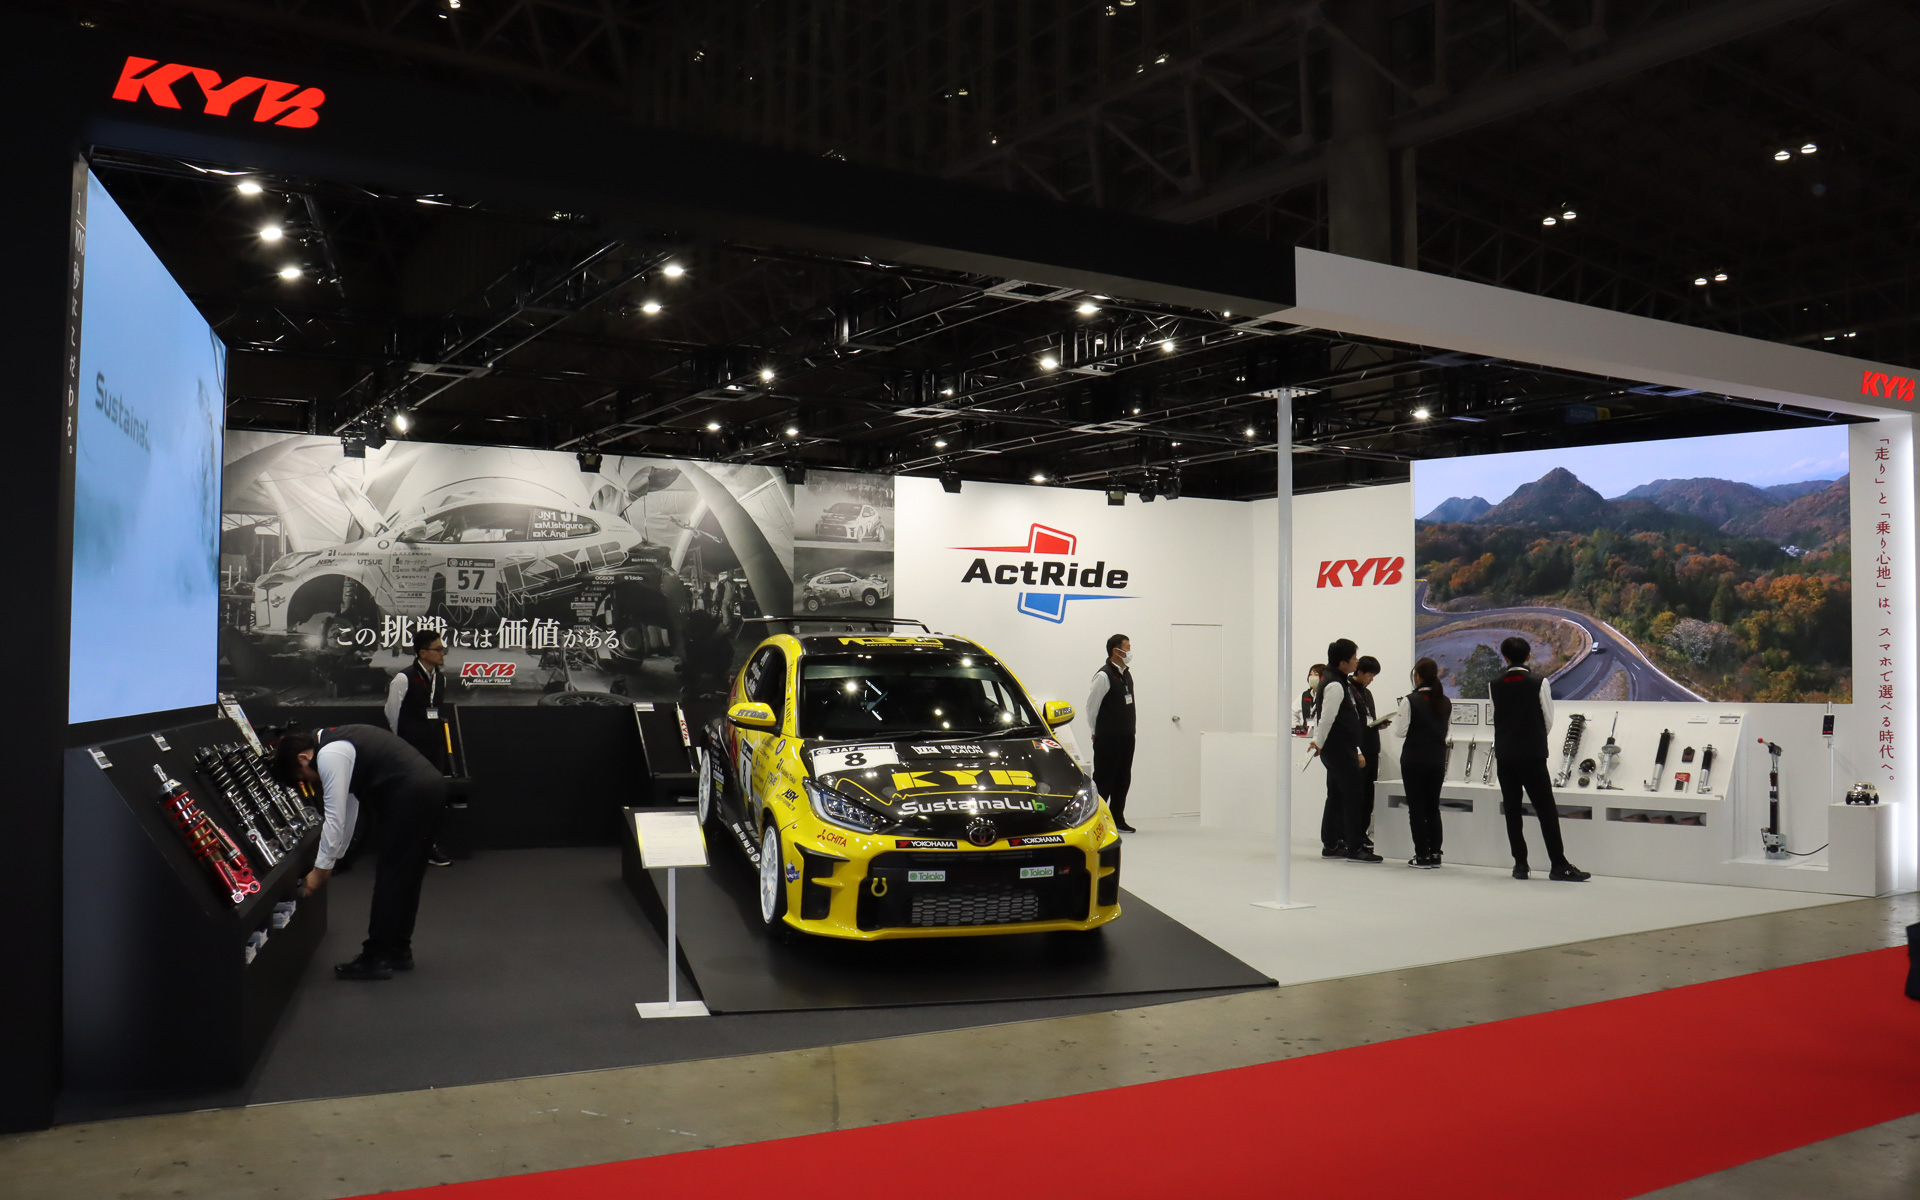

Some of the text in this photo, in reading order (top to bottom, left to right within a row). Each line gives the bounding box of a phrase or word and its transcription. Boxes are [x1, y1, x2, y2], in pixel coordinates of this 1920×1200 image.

[112, 56, 326, 129] KYB
[1861, 370, 1916, 402] KYB
[541, 530, 569, 538] K.Anai
[457, 569, 485, 591] 57
[961, 558, 1129, 589] ActRide
[1316, 556, 1405, 588] KYB
[336, 614, 621, 650] この挑戦には価値がある
[460, 661, 516, 678] KYB
[844, 752, 868, 767] 8
[891, 770, 1037, 791] KYB
[826, 832, 848, 848] CHITA
[911, 840, 955, 849] YOKOHAMA
[1022, 836, 1062, 845] YOKOHAMA
